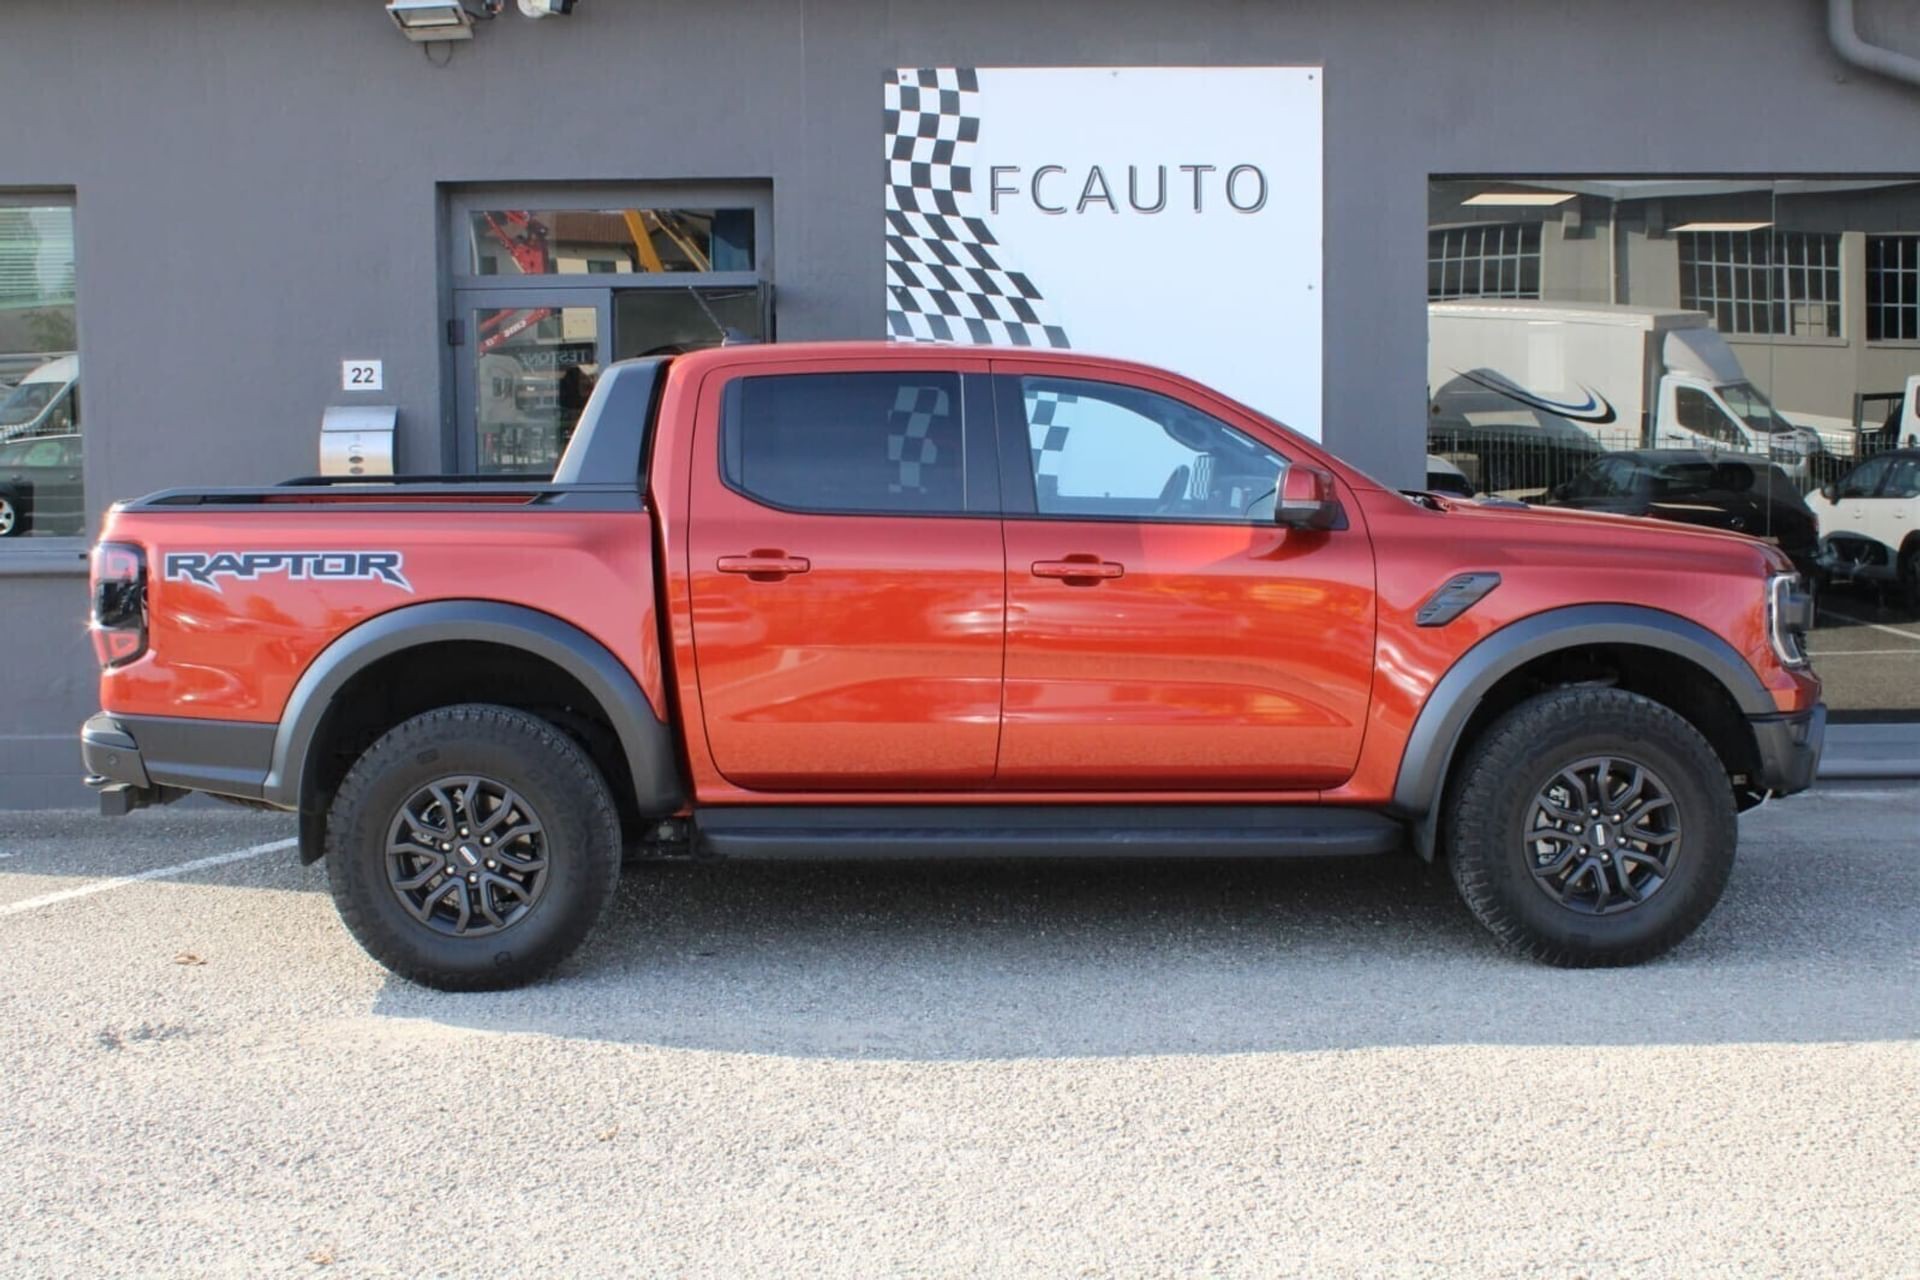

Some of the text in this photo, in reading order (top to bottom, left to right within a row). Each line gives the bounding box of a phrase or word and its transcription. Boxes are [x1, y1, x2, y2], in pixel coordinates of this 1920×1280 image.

[990, 163, 1268, 214] FCAUTO
[351, 367, 375, 383] 22
[164, 550, 416, 594] RAPTOR
